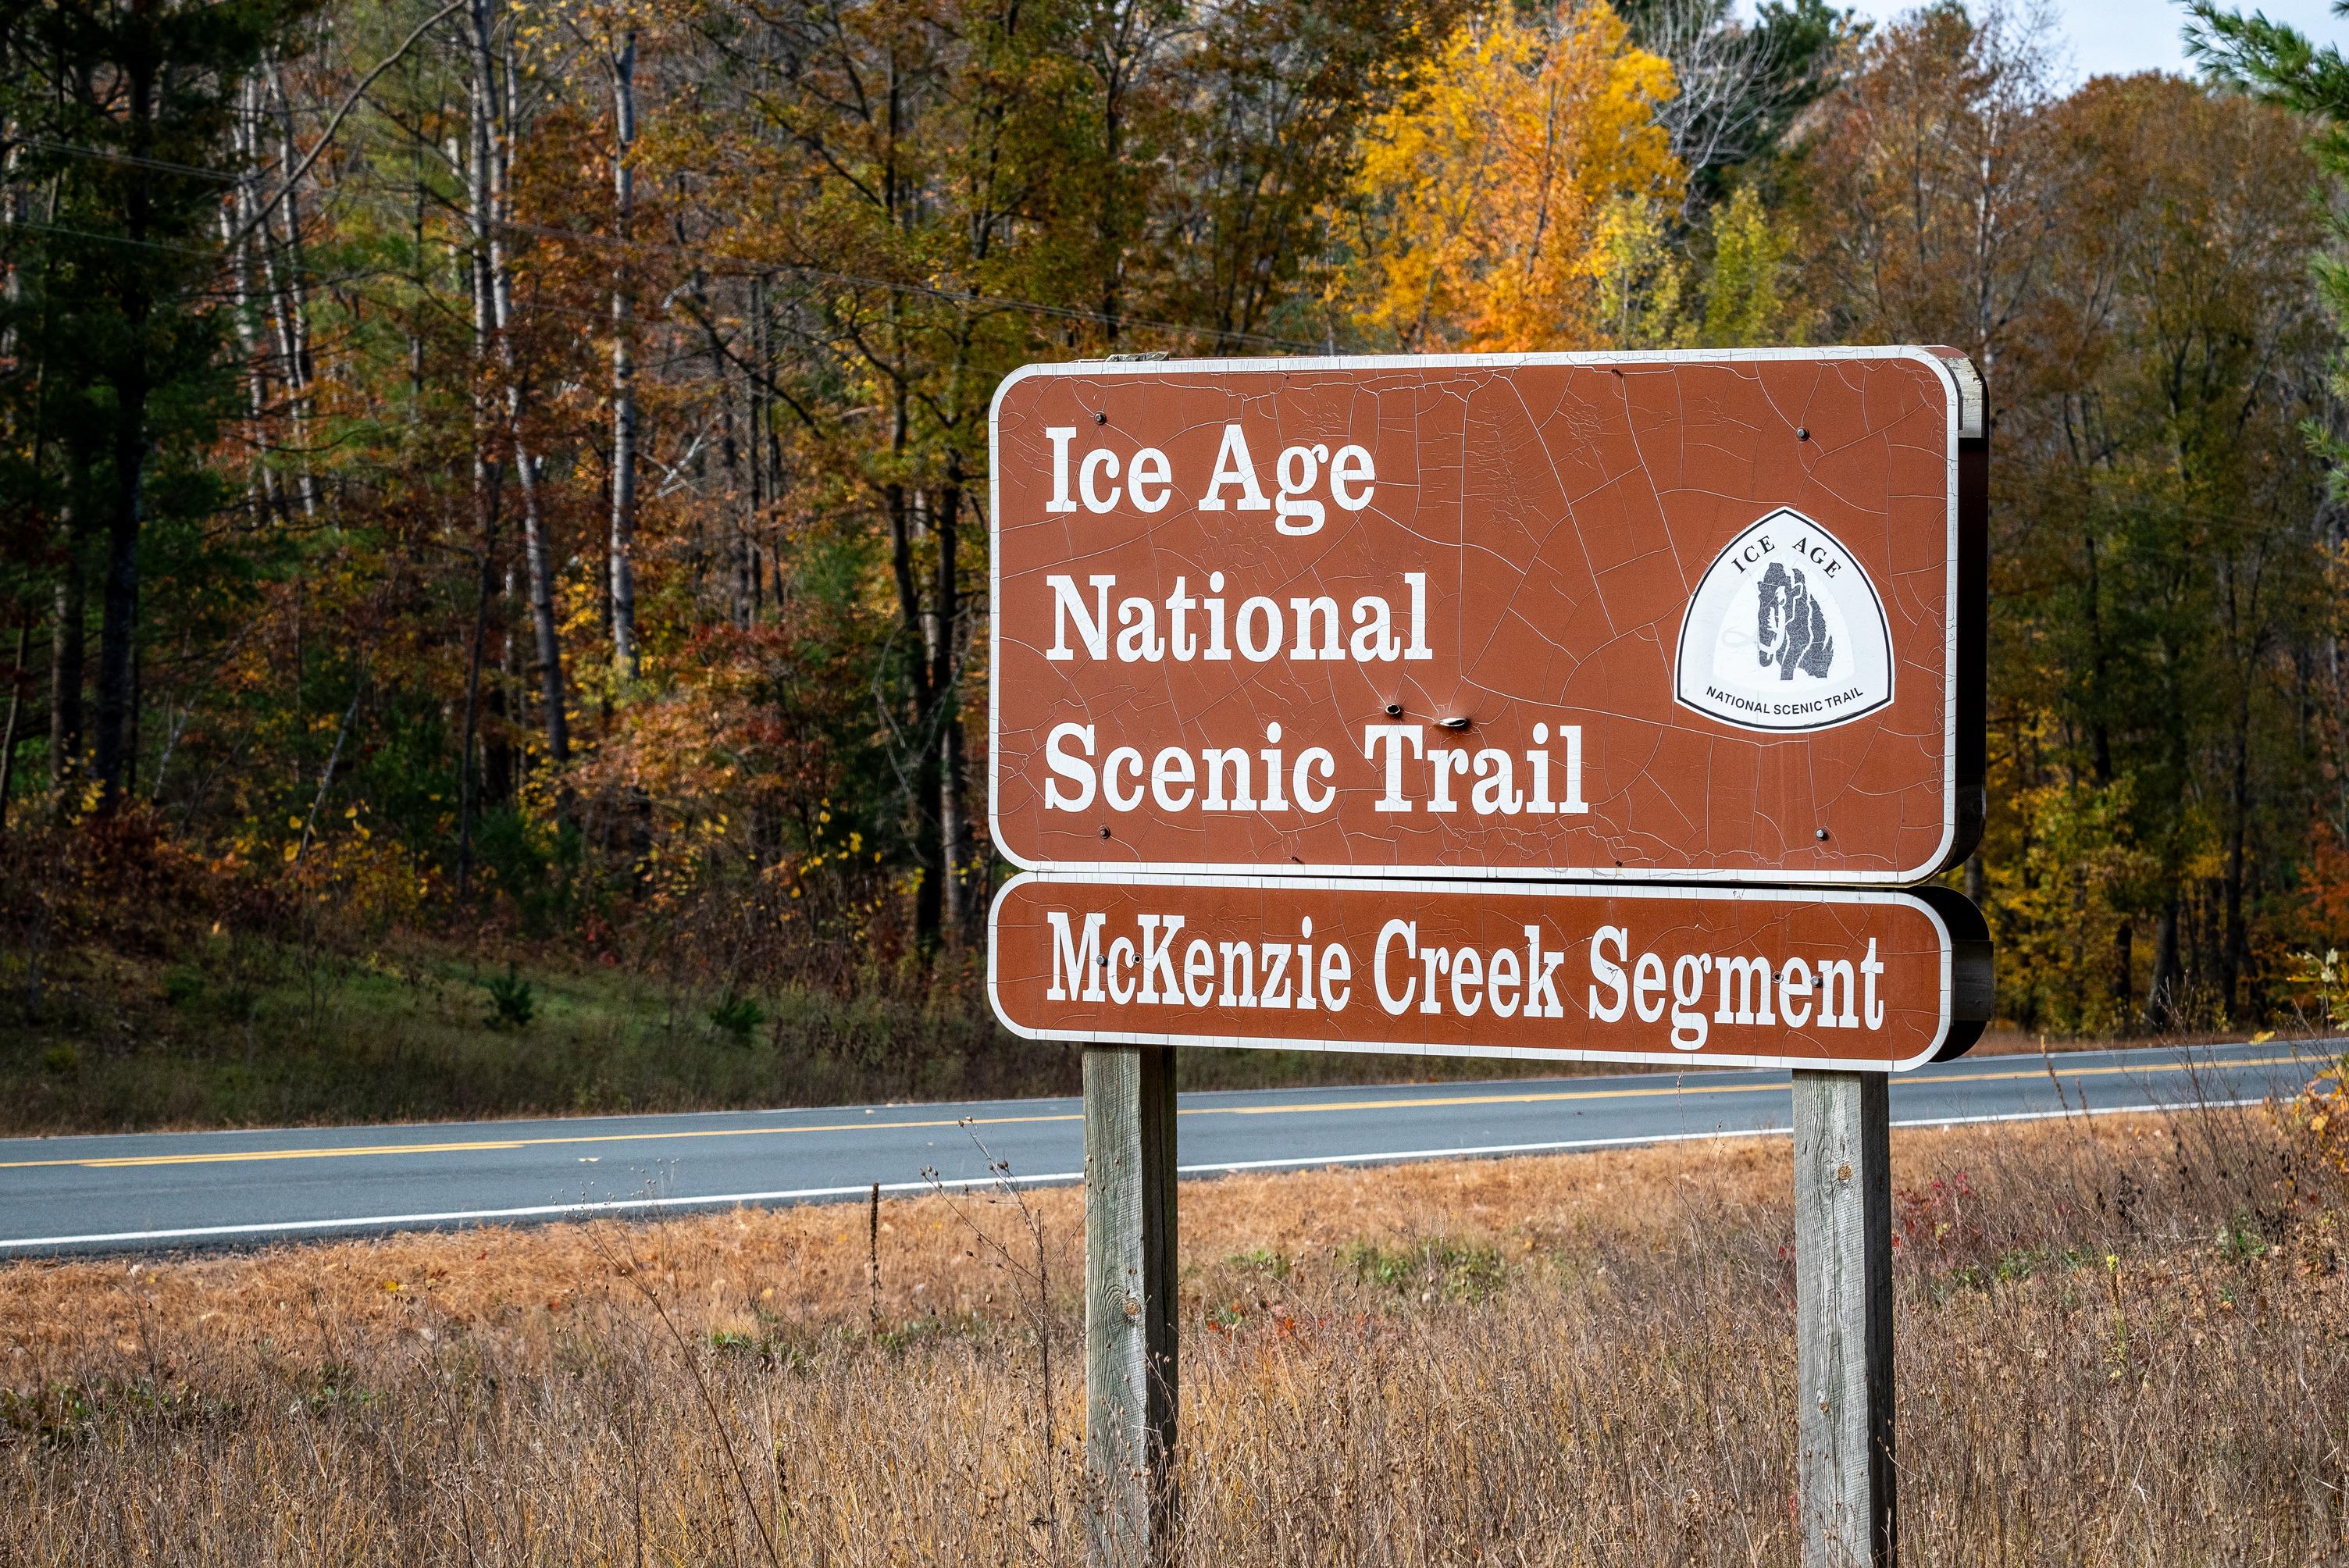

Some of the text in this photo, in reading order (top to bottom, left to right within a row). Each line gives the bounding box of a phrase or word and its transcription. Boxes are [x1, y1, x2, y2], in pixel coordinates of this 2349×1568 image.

[1045, 424, 1377, 536] Ice Age
[1731, 535, 1841, 579] ICE AGE
[1046, 572, 1434, 662] National
[1706, 686, 1864, 715] NATIONAL SCENIC TRAIL
[1044, 722, 1589, 815] Scenic Trail
[1047, 912, 1884, 1052] McKenzie Creek Segment
